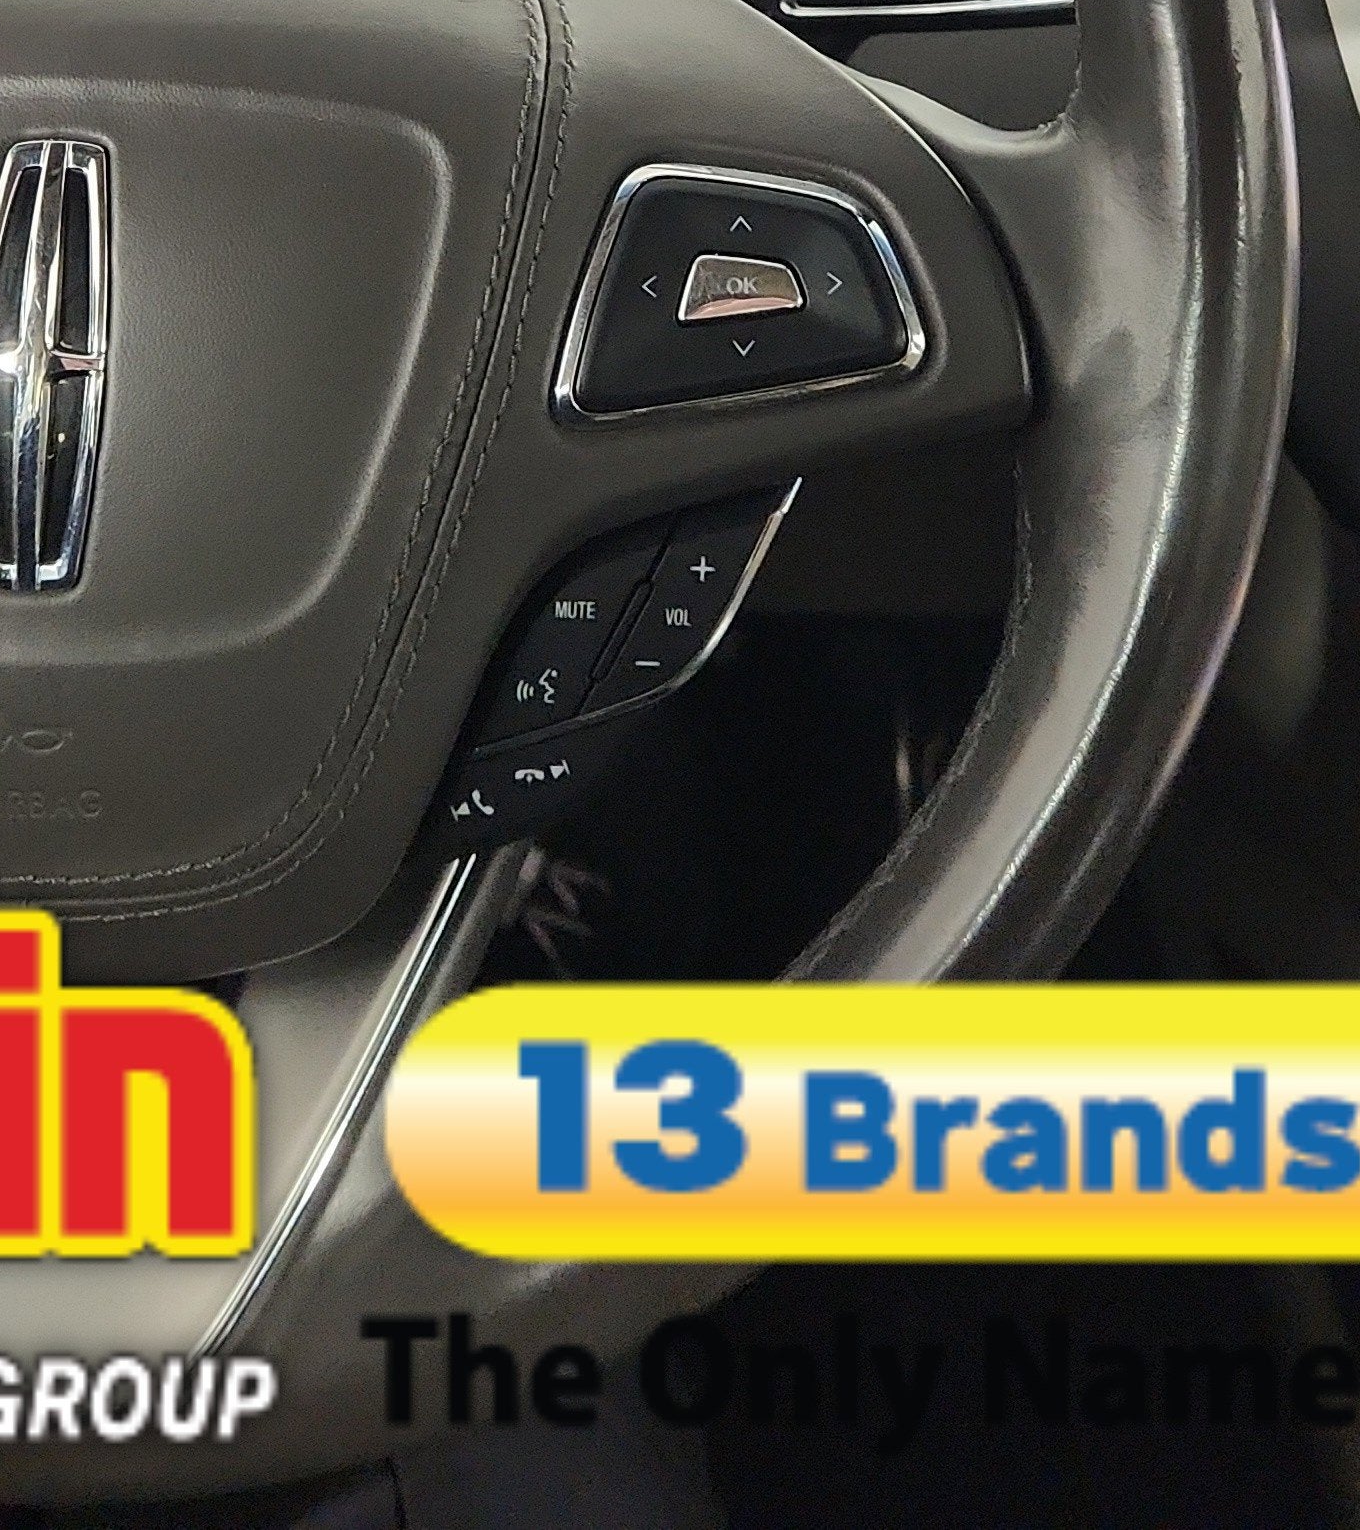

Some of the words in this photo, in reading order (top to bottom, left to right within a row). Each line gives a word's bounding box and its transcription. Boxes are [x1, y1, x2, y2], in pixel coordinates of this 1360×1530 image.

[726, 277, 759, 295] OK
[554, 601, 596, 620] MUTE
[665, 608, 691, 627] VOL
